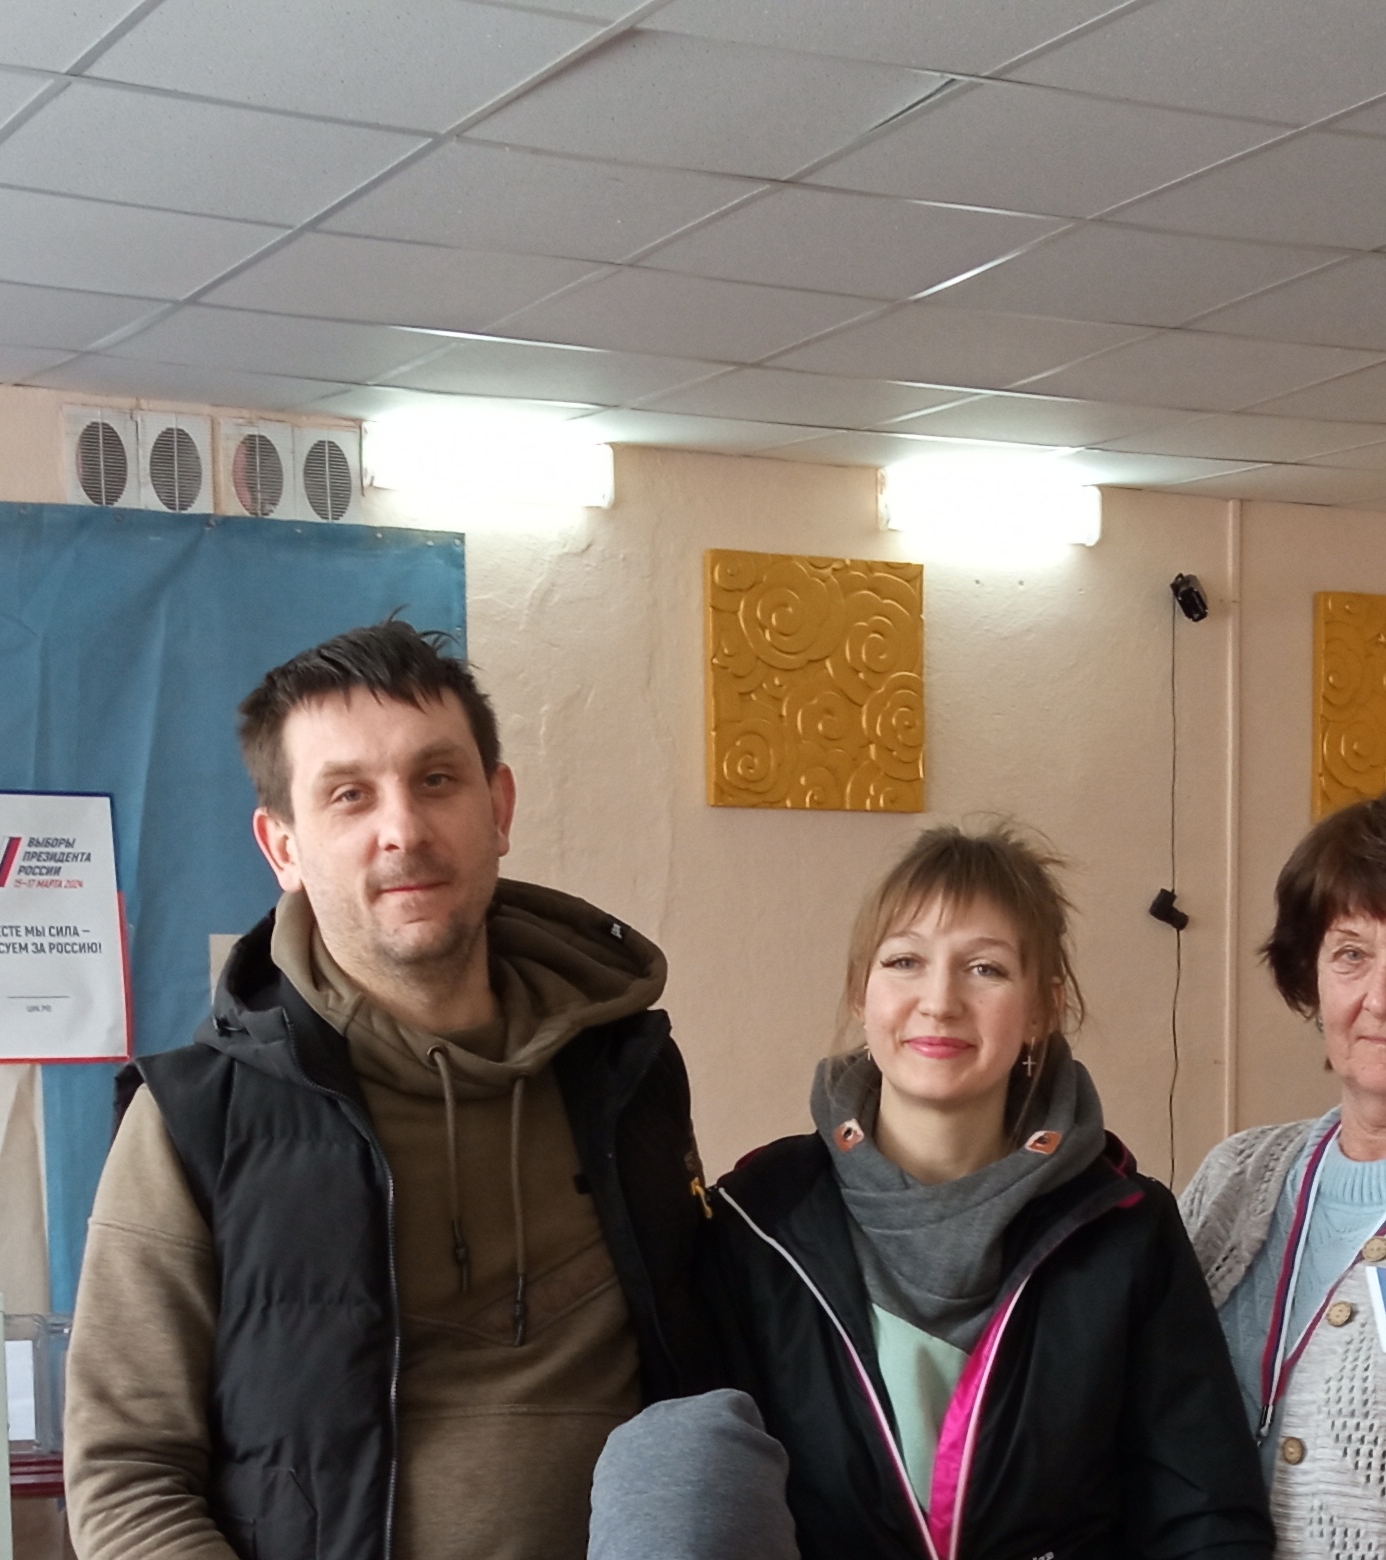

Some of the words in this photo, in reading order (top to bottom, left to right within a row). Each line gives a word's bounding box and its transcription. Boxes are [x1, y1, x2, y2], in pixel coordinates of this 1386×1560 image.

[27, 837, 76, 848] ВЫБОРЫ
[22, 851, 92, 863] ПРЕЗИДЕНТА
[17, 865, 62, 876] РОССИИ
[25, 925, 46, 938] МЫ
[49, 925, 80, 938] СИЛА
[31, 942, 46, 954] ЗА
[48, 942, 102, 954] РОССИЮ!
